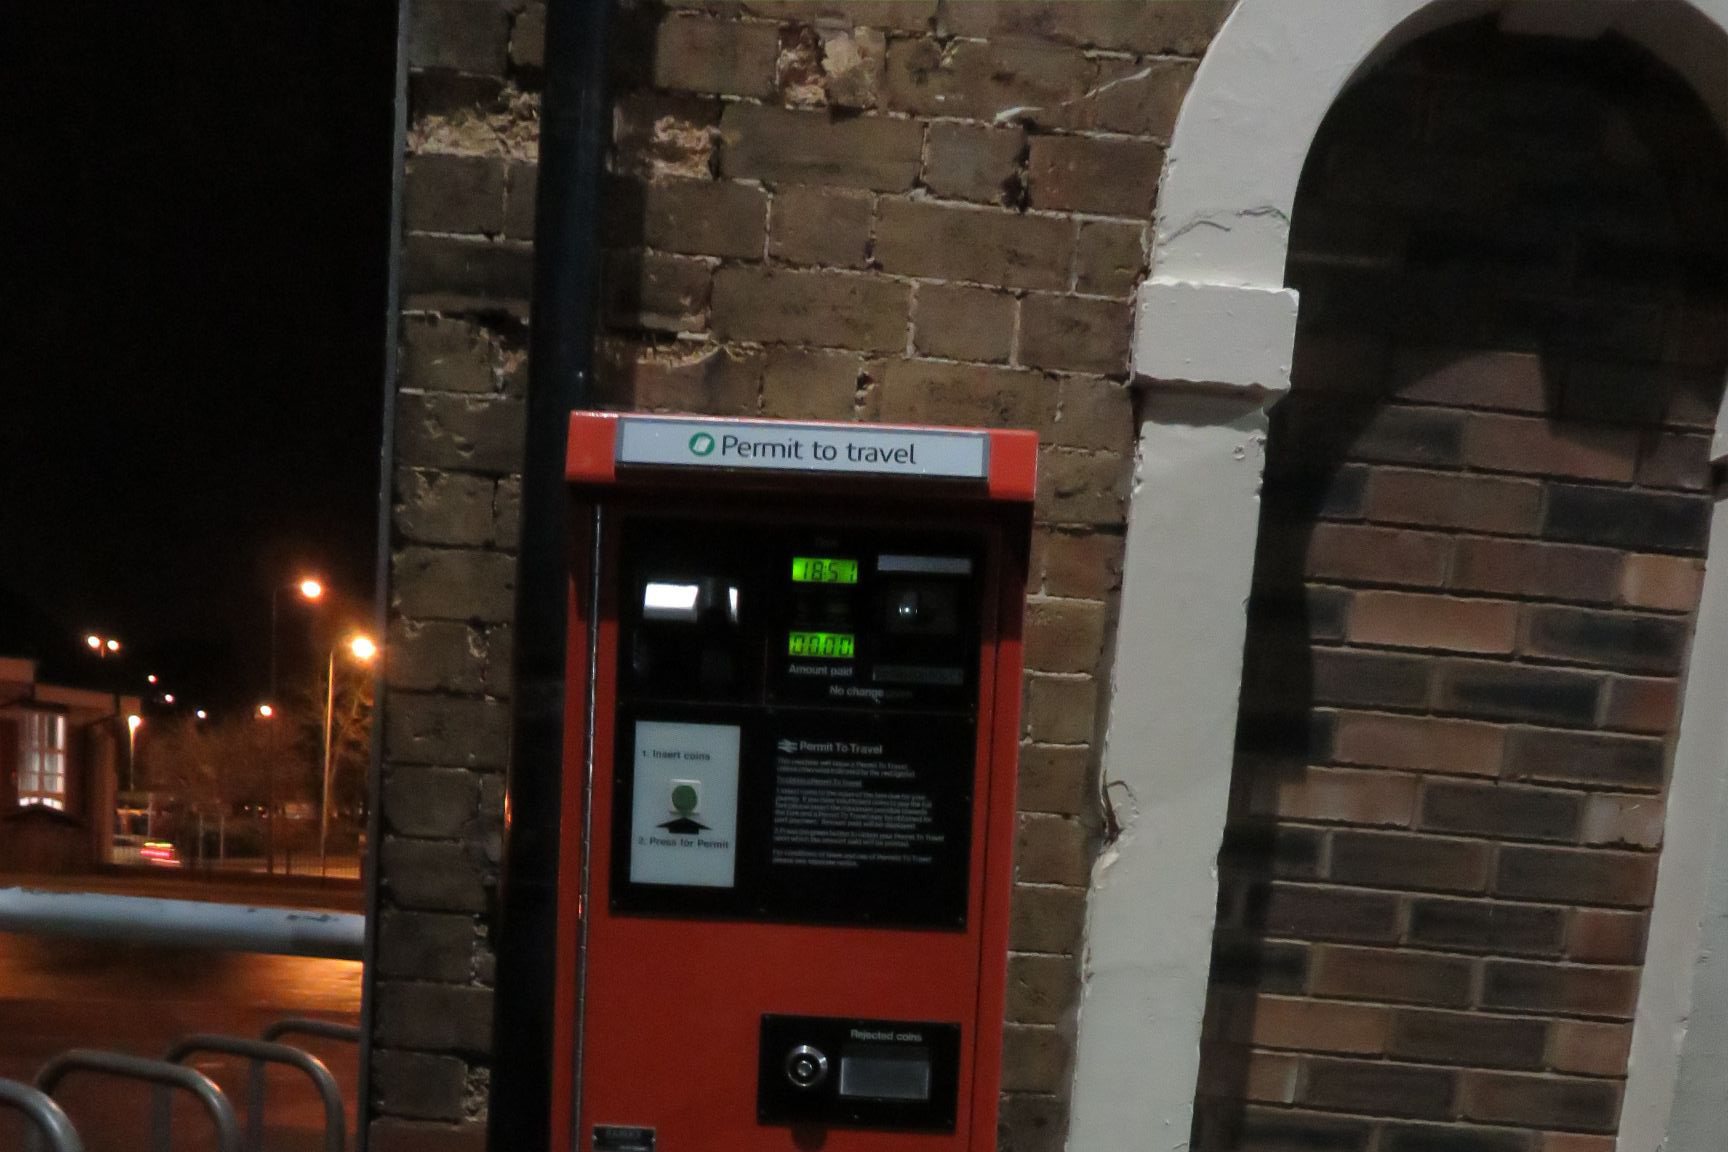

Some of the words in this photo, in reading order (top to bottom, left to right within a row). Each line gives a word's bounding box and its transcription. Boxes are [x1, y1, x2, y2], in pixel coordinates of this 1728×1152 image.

[721, 434, 803, 459] Permit
[812, 439, 837, 460] to
[847, 442, 917, 465] travel
[788, 664, 828, 676] Amount
[830, 666, 853, 678] paid
[829, 685, 844, 696] No
[846, 686, 884, 699] change
[799, 740, 833, 752] Permit
[835, 742, 849, 753] To
[850, 743, 883, 755] Travel
[652, 749, 682, 760] Insert
[684, 751, 711, 761] coins
[649, 836, 677, 848] Press
[679, 837, 694, 848] for
[697, 838, 729, 849] Permit
[850, 1028, 894, 1042] Rejected
[896, 1032, 922, 1042] coins
